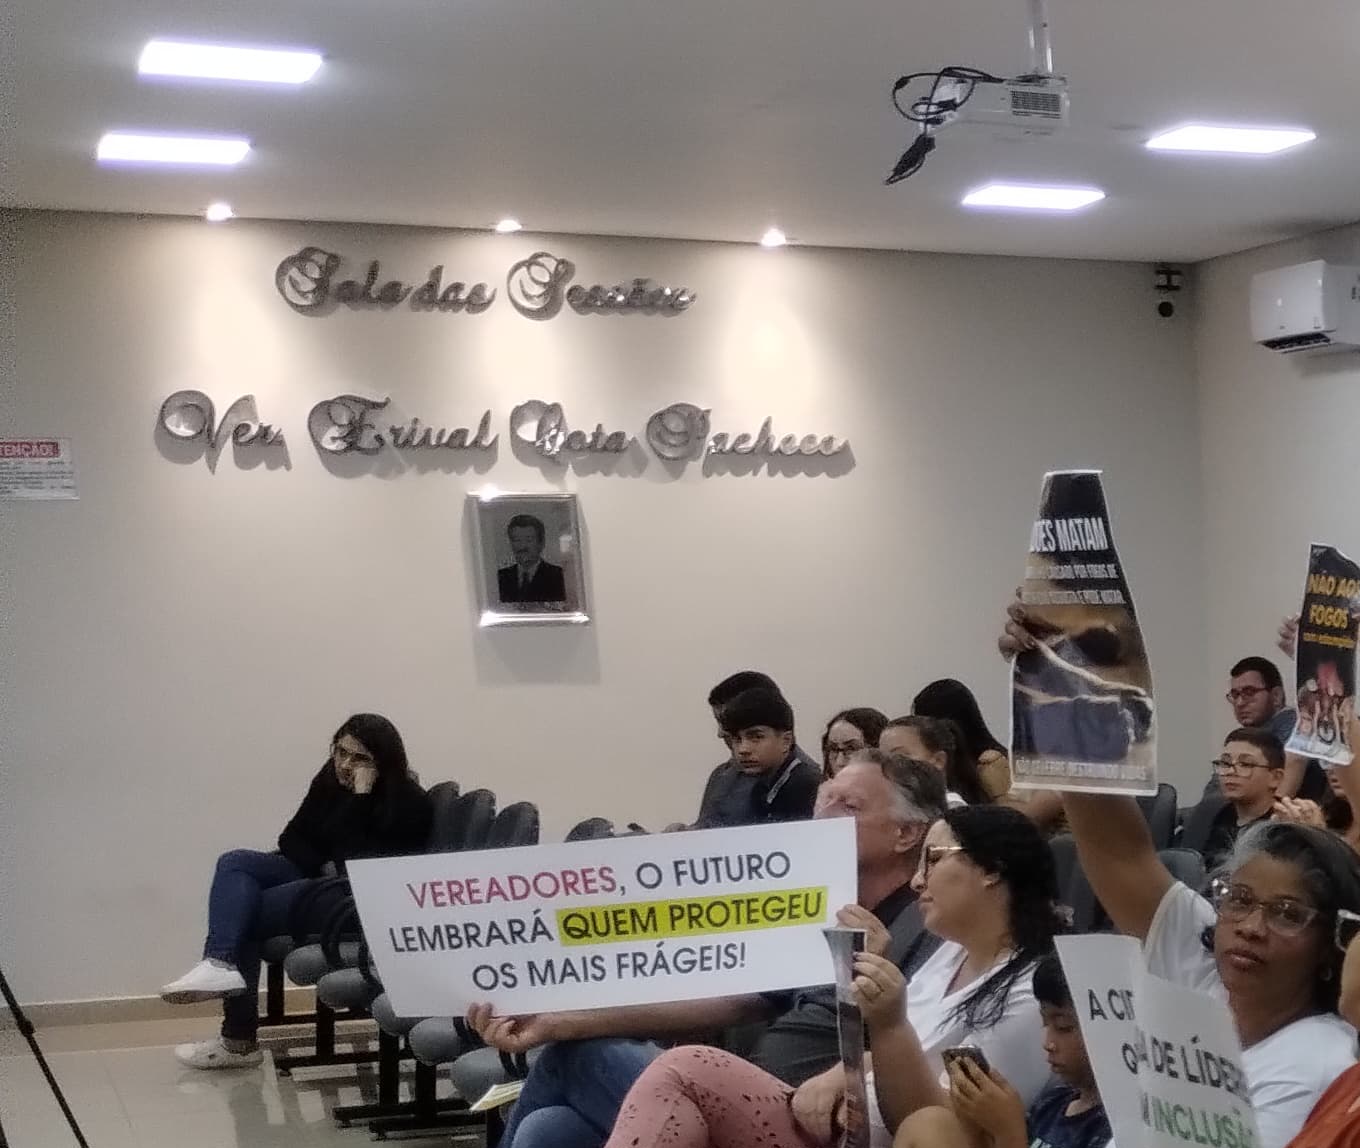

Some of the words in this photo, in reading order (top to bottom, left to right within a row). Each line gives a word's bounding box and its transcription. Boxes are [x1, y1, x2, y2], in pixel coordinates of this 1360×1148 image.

[1055, 517, 1108, 552] MATAM
[1308, 570, 1336, 596] NÃO
[1309, 604, 1350, 628] FOGOS
[406, 866, 627, 908] VEREADORES,
[636, 862, 664, 890] O
[674, 851, 791, 888] FUTURO
[388, 908, 555, 953] LEMBRARÁ
[562, 906, 659, 940] QUEM
[669, 891, 823, 931] PROTEGEU
[472, 963, 518, 991] OS
[529, 954, 606, 987] MAIS
[616, 942, 747, 980] FRÁGEIS!
[1088, 989, 1108, 1021] A
[1151, 1036, 1179, 1079] DE
